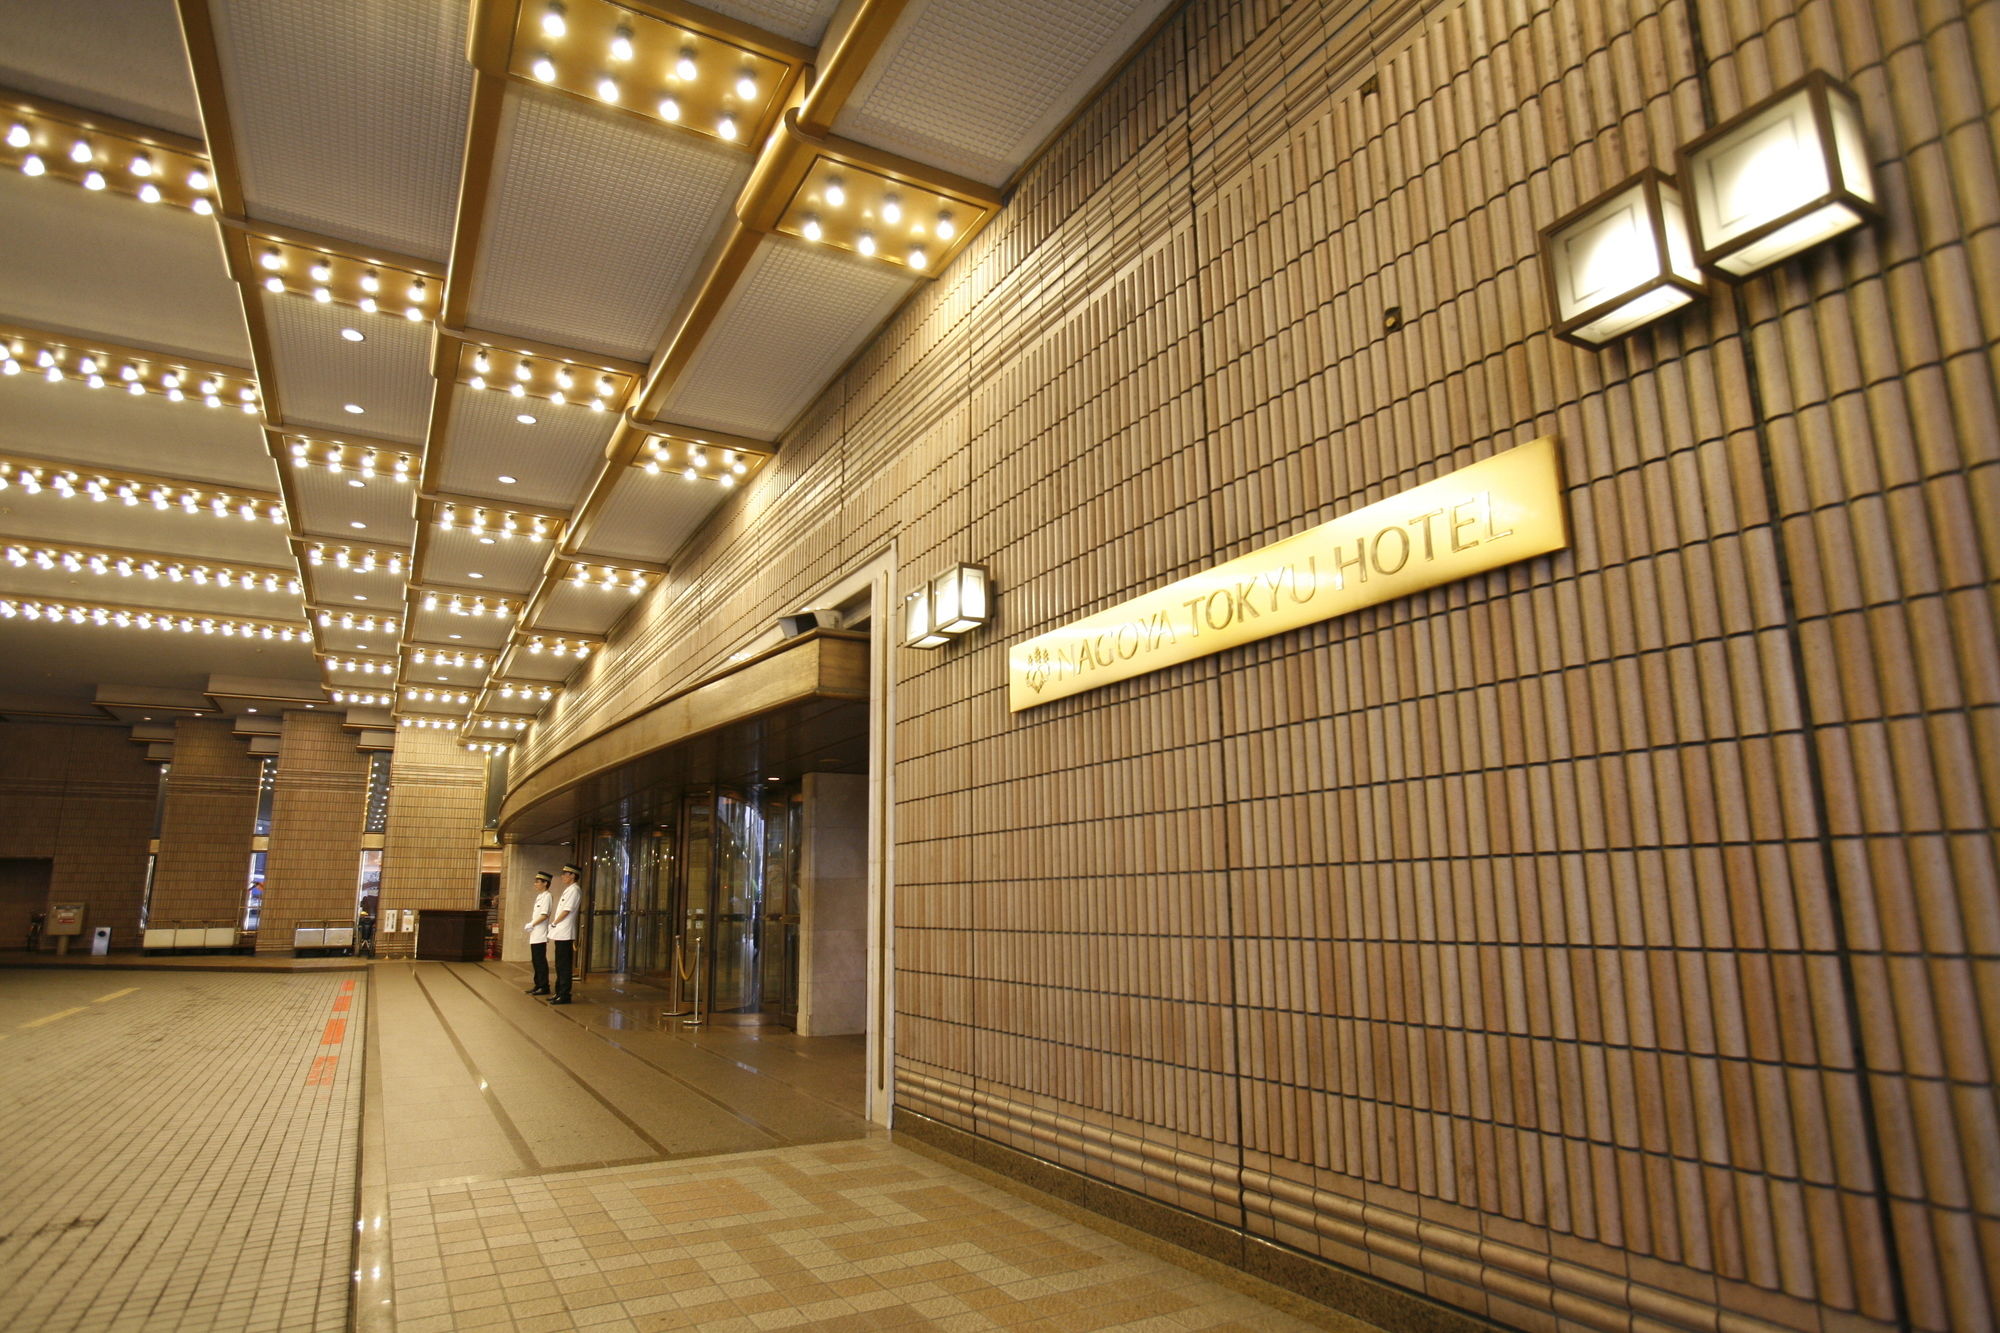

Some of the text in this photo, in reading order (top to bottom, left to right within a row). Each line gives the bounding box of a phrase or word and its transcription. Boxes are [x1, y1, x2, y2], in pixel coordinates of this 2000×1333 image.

[1057, 490, 1513, 682] NAGOYA TOKYU HOTEL
